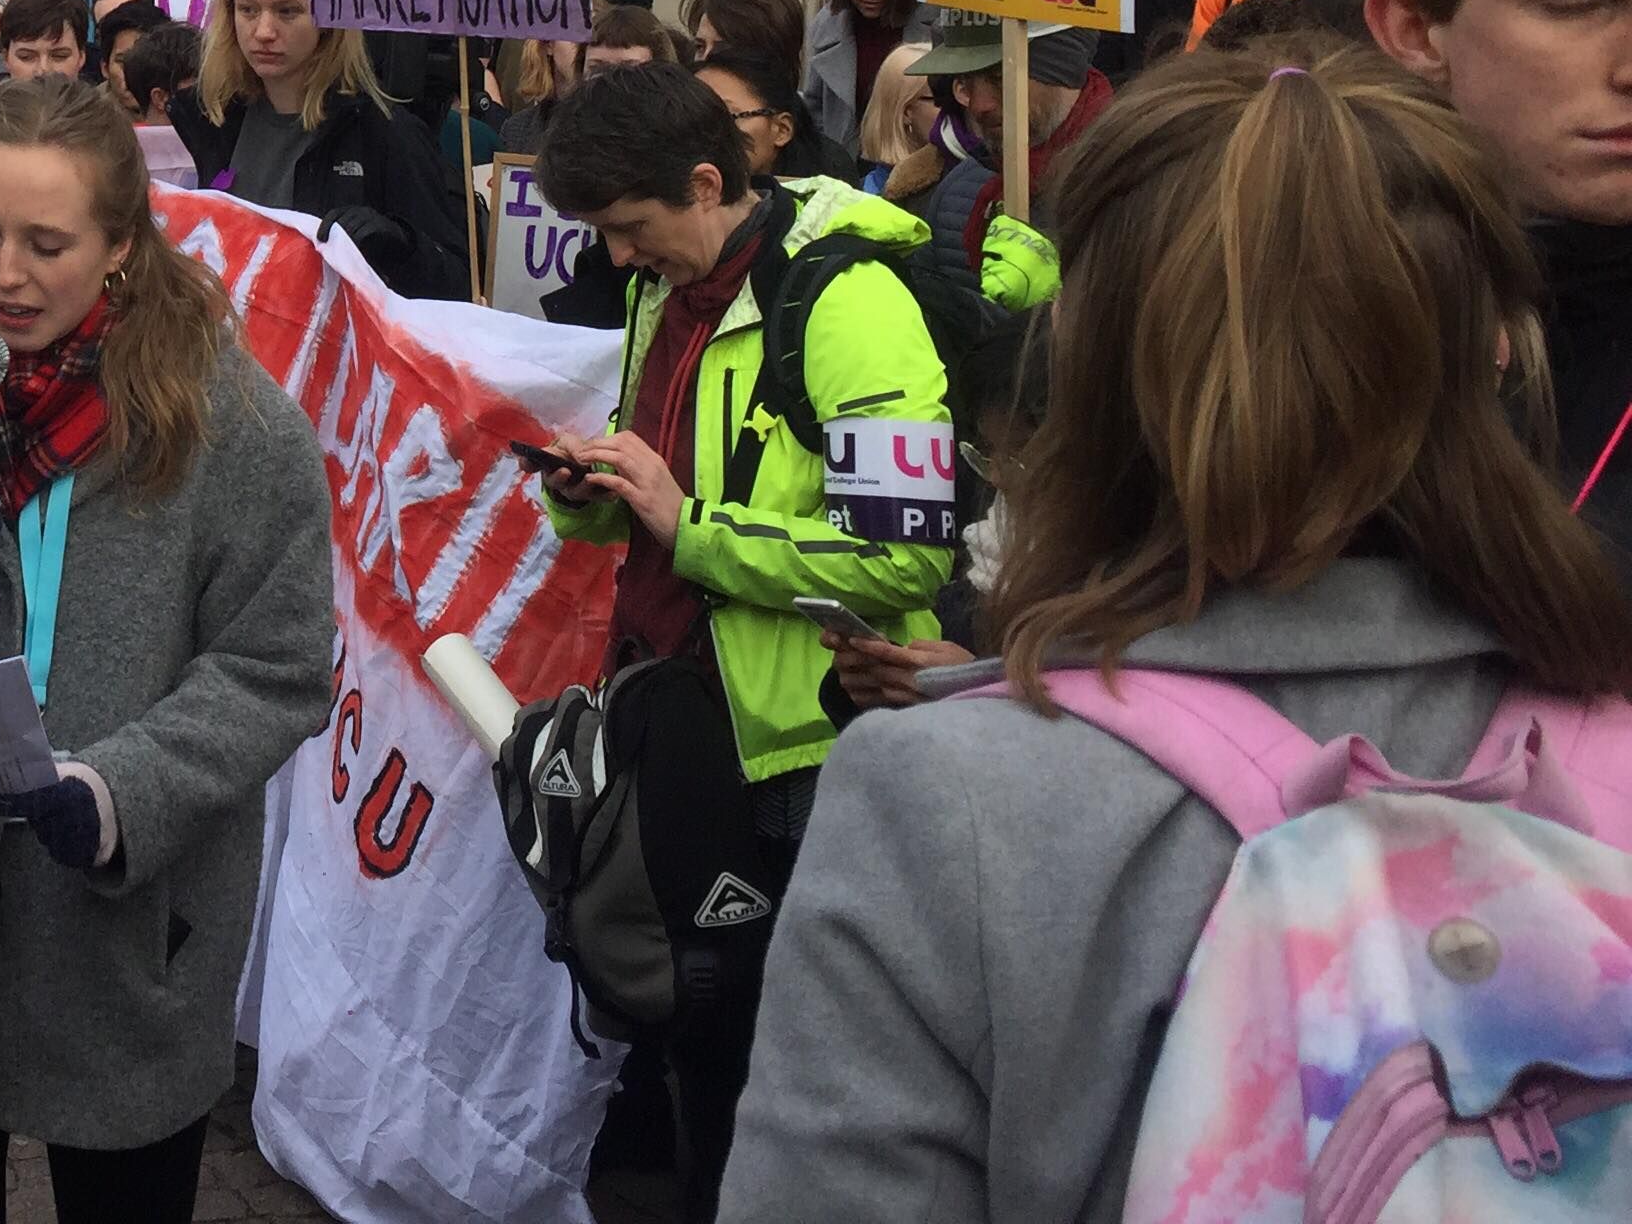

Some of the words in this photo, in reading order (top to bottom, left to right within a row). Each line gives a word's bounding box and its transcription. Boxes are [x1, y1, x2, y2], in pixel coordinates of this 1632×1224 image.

[524, 224, 592, 286] UC
[542, 781, 575, 793] ALTURA
[703, 903, 766, 924] ALTURA
